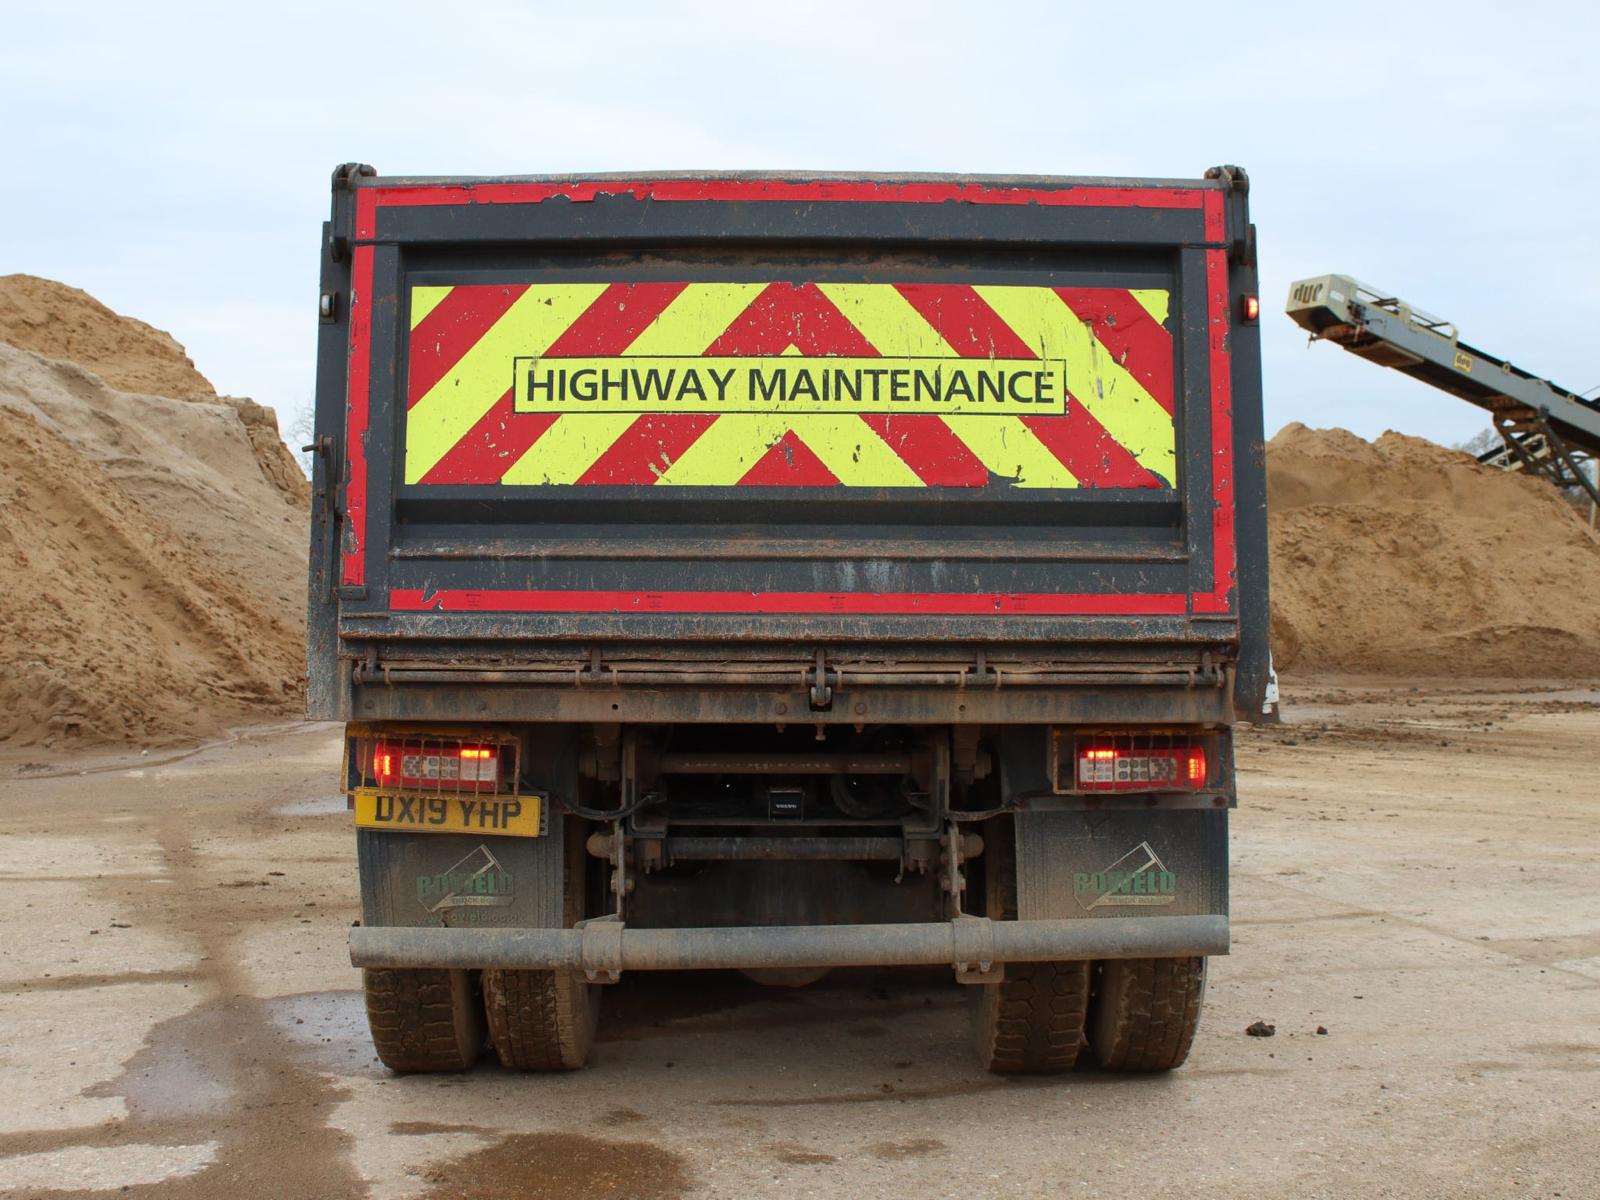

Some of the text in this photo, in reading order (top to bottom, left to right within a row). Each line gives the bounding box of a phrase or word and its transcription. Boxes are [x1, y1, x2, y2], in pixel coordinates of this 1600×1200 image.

[527, 368, 1056, 404] HIGHWAY MAINTENANCE
[374, 794, 522, 829] DX19 YHP
[1072, 871, 1176, 893] BOWELD
